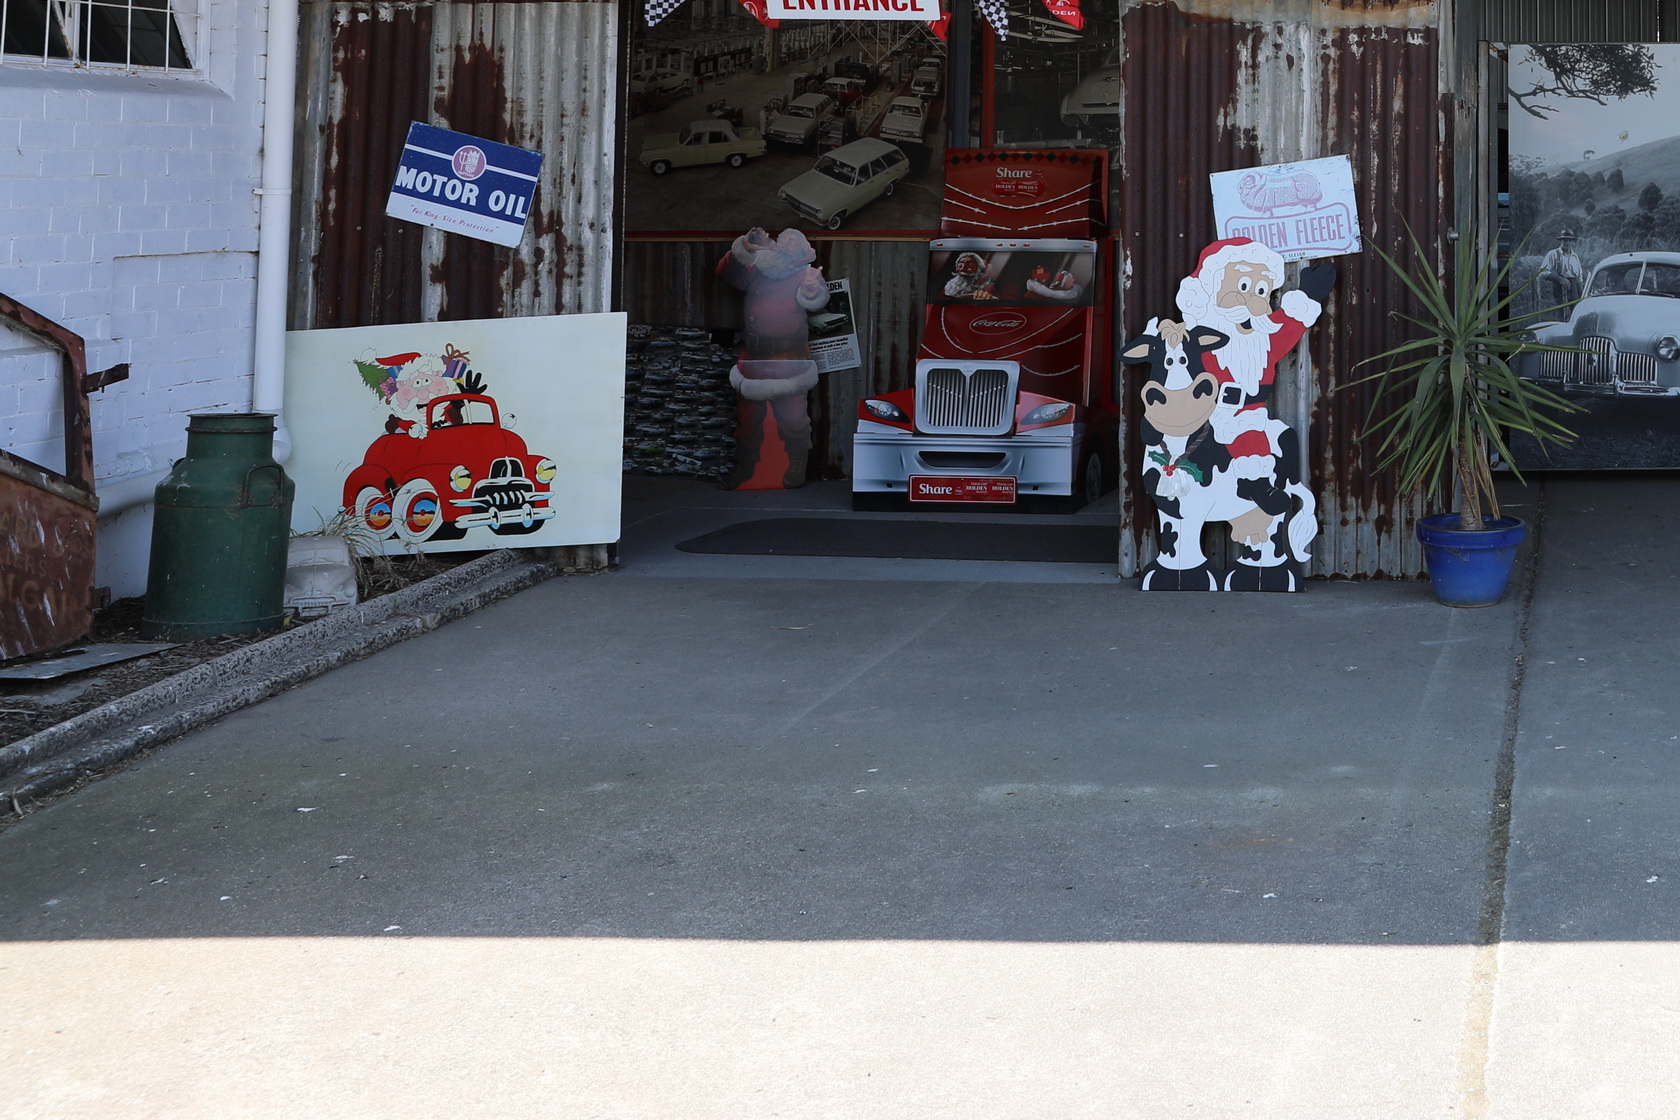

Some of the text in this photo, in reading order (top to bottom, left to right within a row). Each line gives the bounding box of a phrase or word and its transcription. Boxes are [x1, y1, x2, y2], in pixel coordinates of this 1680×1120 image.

[995, 166, 1033, 178] Share
[395, 165, 527, 219] MOTOR OIL
[1295, 213, 1345, 246] FLEECE
[918, 482, 953, 495] Share
